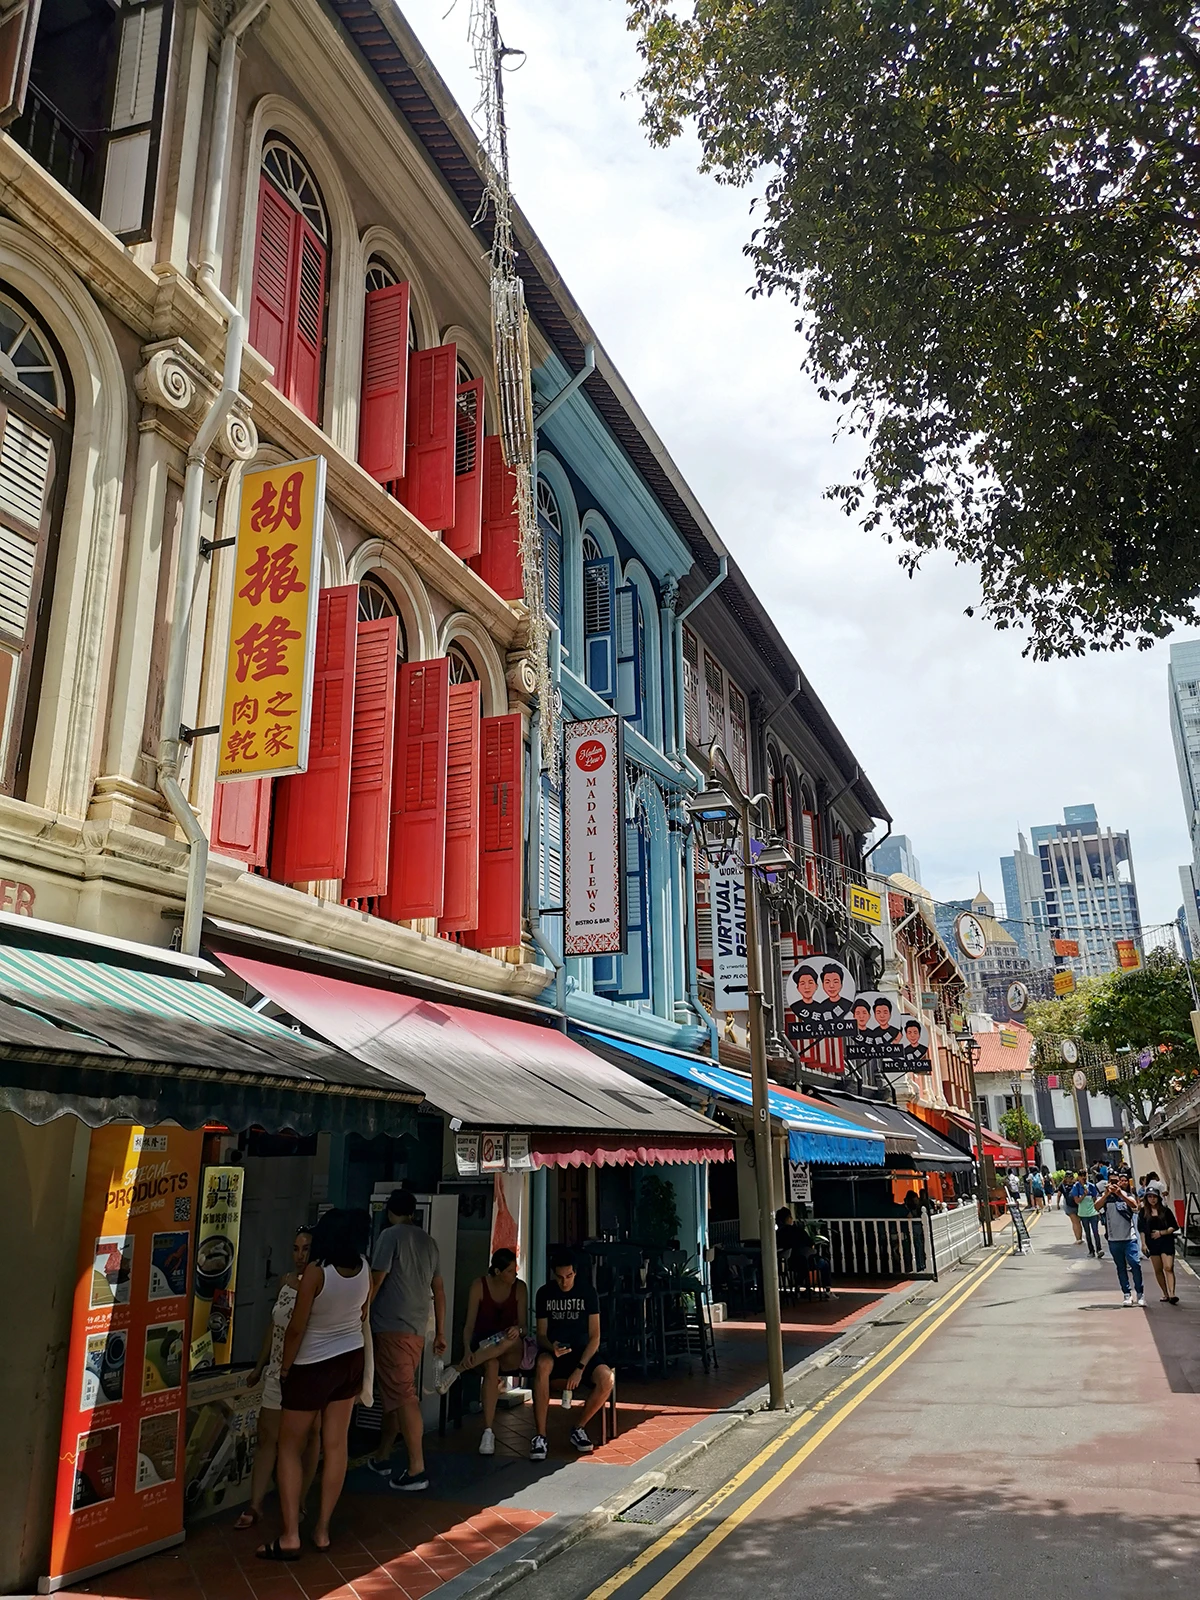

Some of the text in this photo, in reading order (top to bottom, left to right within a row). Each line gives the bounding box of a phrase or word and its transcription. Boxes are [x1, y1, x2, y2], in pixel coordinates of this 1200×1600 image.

[234, 471, 306, 683] 胡振隆
[585, 778, 598, 837] MADAM
[585, 851, 598, 913] LIEWS
[853, 894, 870, 912] EAT
[715, 879, 734, 957] VIRTUAL
[792, 1022, 854, 1033] NIC & TOM
[849, 1046, 866, 1054] NIC
[760, 1107, 767, 1122] 9
[124, 1160, 172, 1186] SPECIAL
[105, 1171, 189, 1213] PRODUCTS
[126, 1202, 148, 1218] SINCE
[546, 1298, 586, 1311] HOLLISTER
[551, 1311, 566, 1320] SURF
